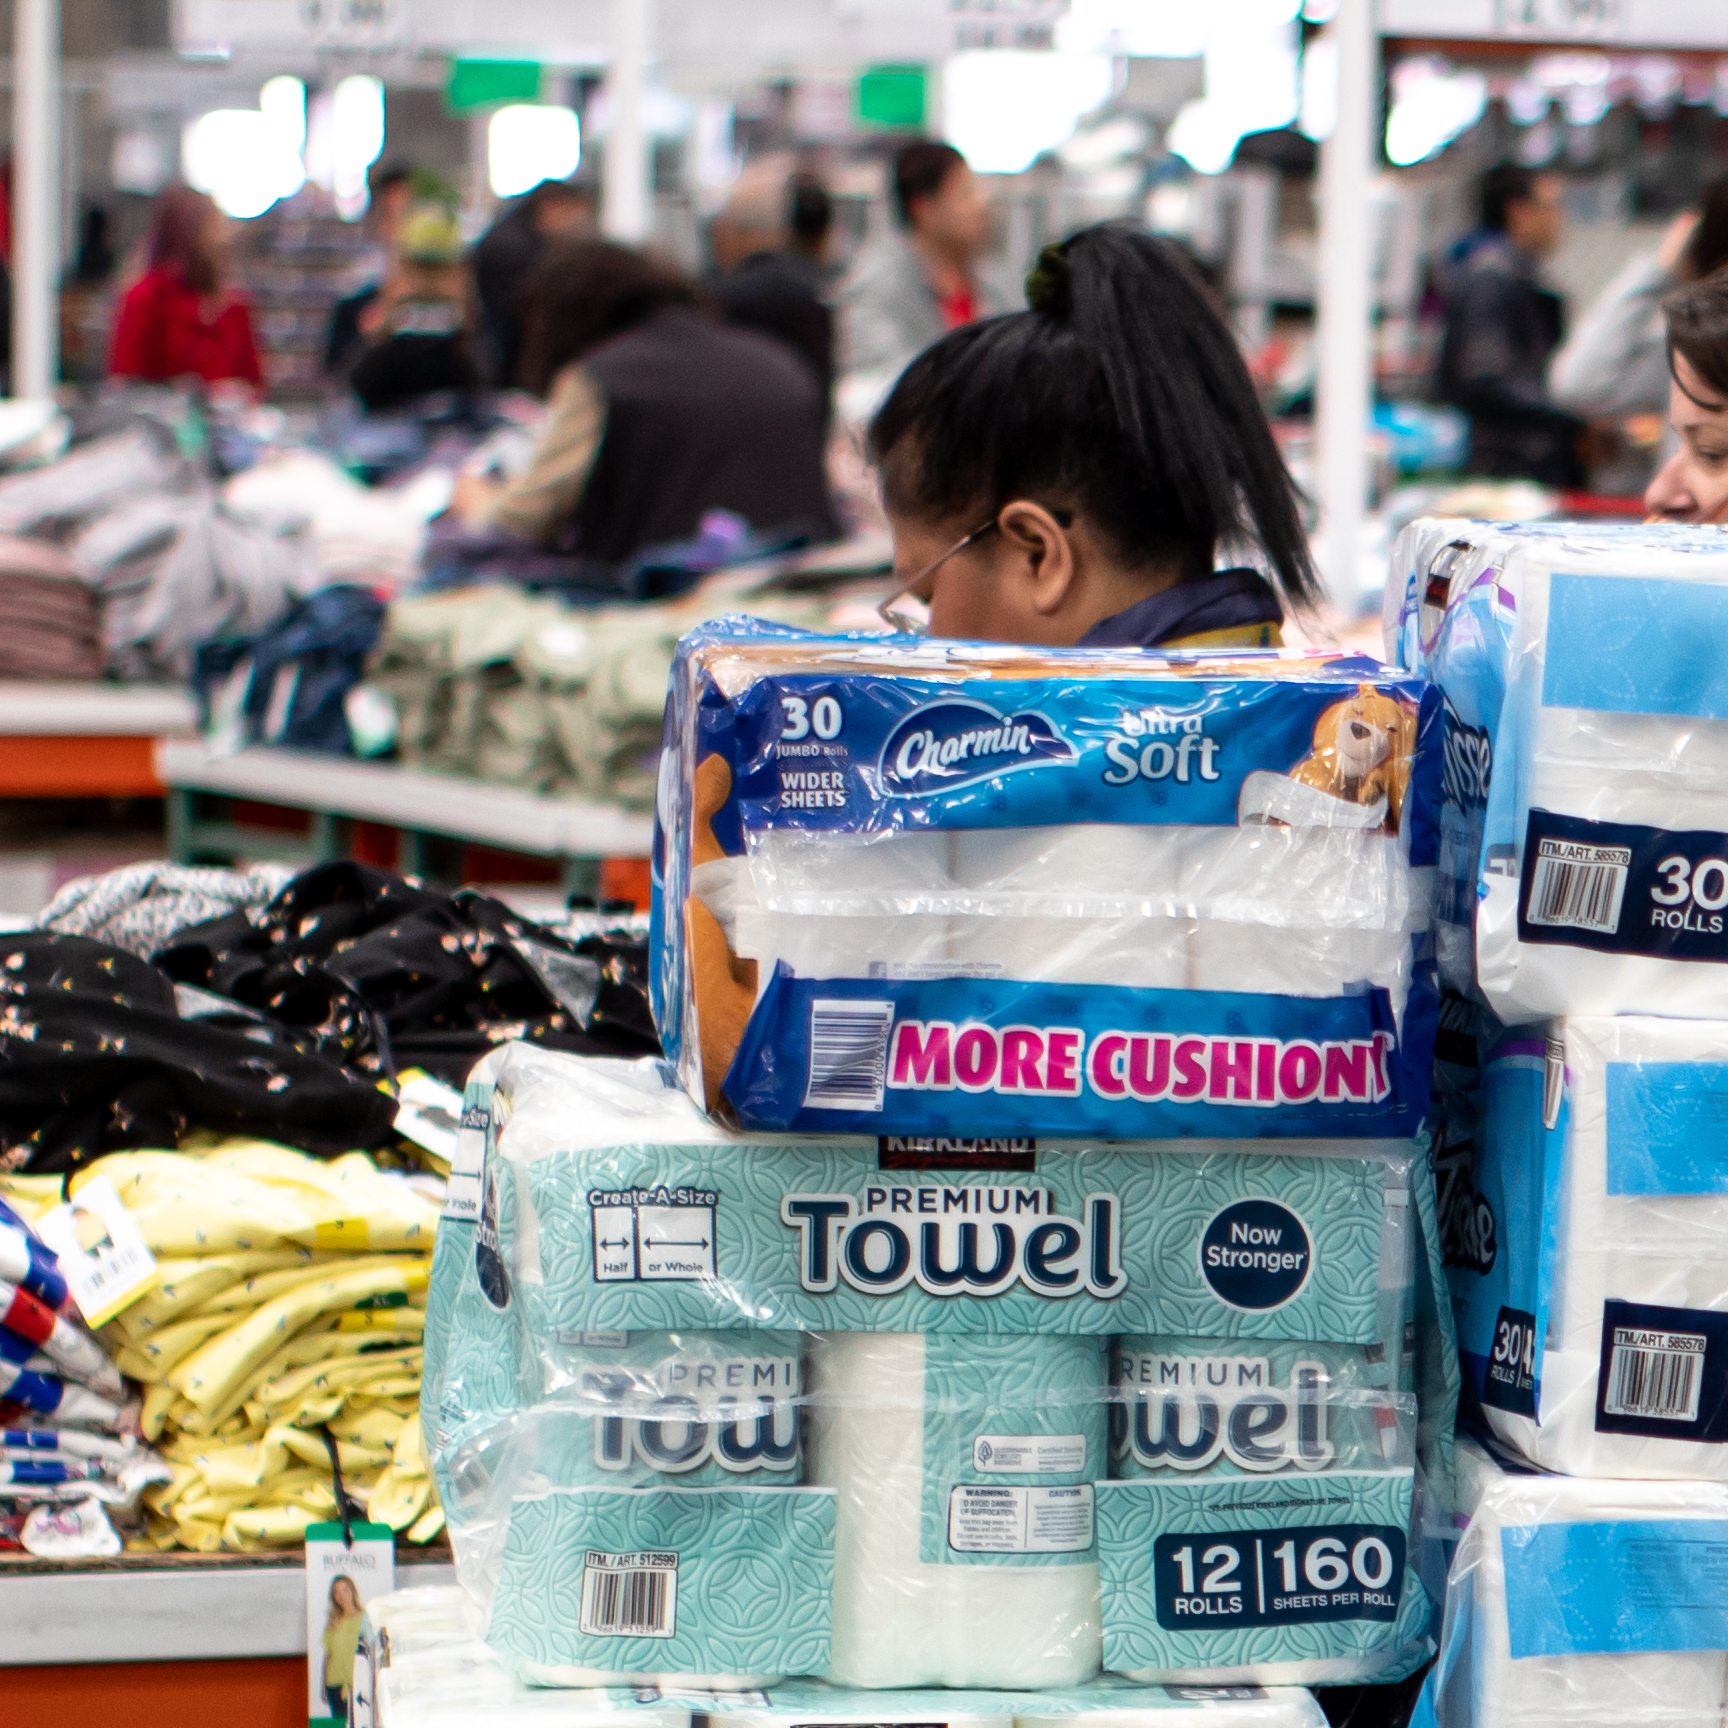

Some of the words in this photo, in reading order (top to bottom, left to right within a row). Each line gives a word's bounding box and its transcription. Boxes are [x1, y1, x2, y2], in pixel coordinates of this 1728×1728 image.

[781, 696, 842, 740] 30
[896, 716, 1031, 780] Charmin
[1104, 736, 1220, 784] Soft
[782, 773, 843, 791] WIDER
[781, 791, 846, 808] SHEETS
[1650, 907, 1724, 934] ROLLS
[890, 1022, 1083, 1096] MORE
[588, 1188, 716, 1206] Create-A-Size
[867, 1187, 1040, 1214] PREMIUM
[787, 1197, 1120, 1292] Towel
[1231, 1222, 1282, 1246] Now
[603, 1262, 628, 1272] Half
[648, 1263, 662, 1272] or
[666, 1262, 703, 1272] Whole
[1206, 1247, 1304, 1271] Stronger
[1170, 1544, 1237, 1593] 12
[1272, 1537, 1394, 1593] 160
[1174, 1595, 1244, 1616] ROLLS
[1273, 1595, 1327, 1612] SHEETS
[1331, 1594, 1358, 1609] PER
[1362, 1592, 1394, 1608] ROLL
